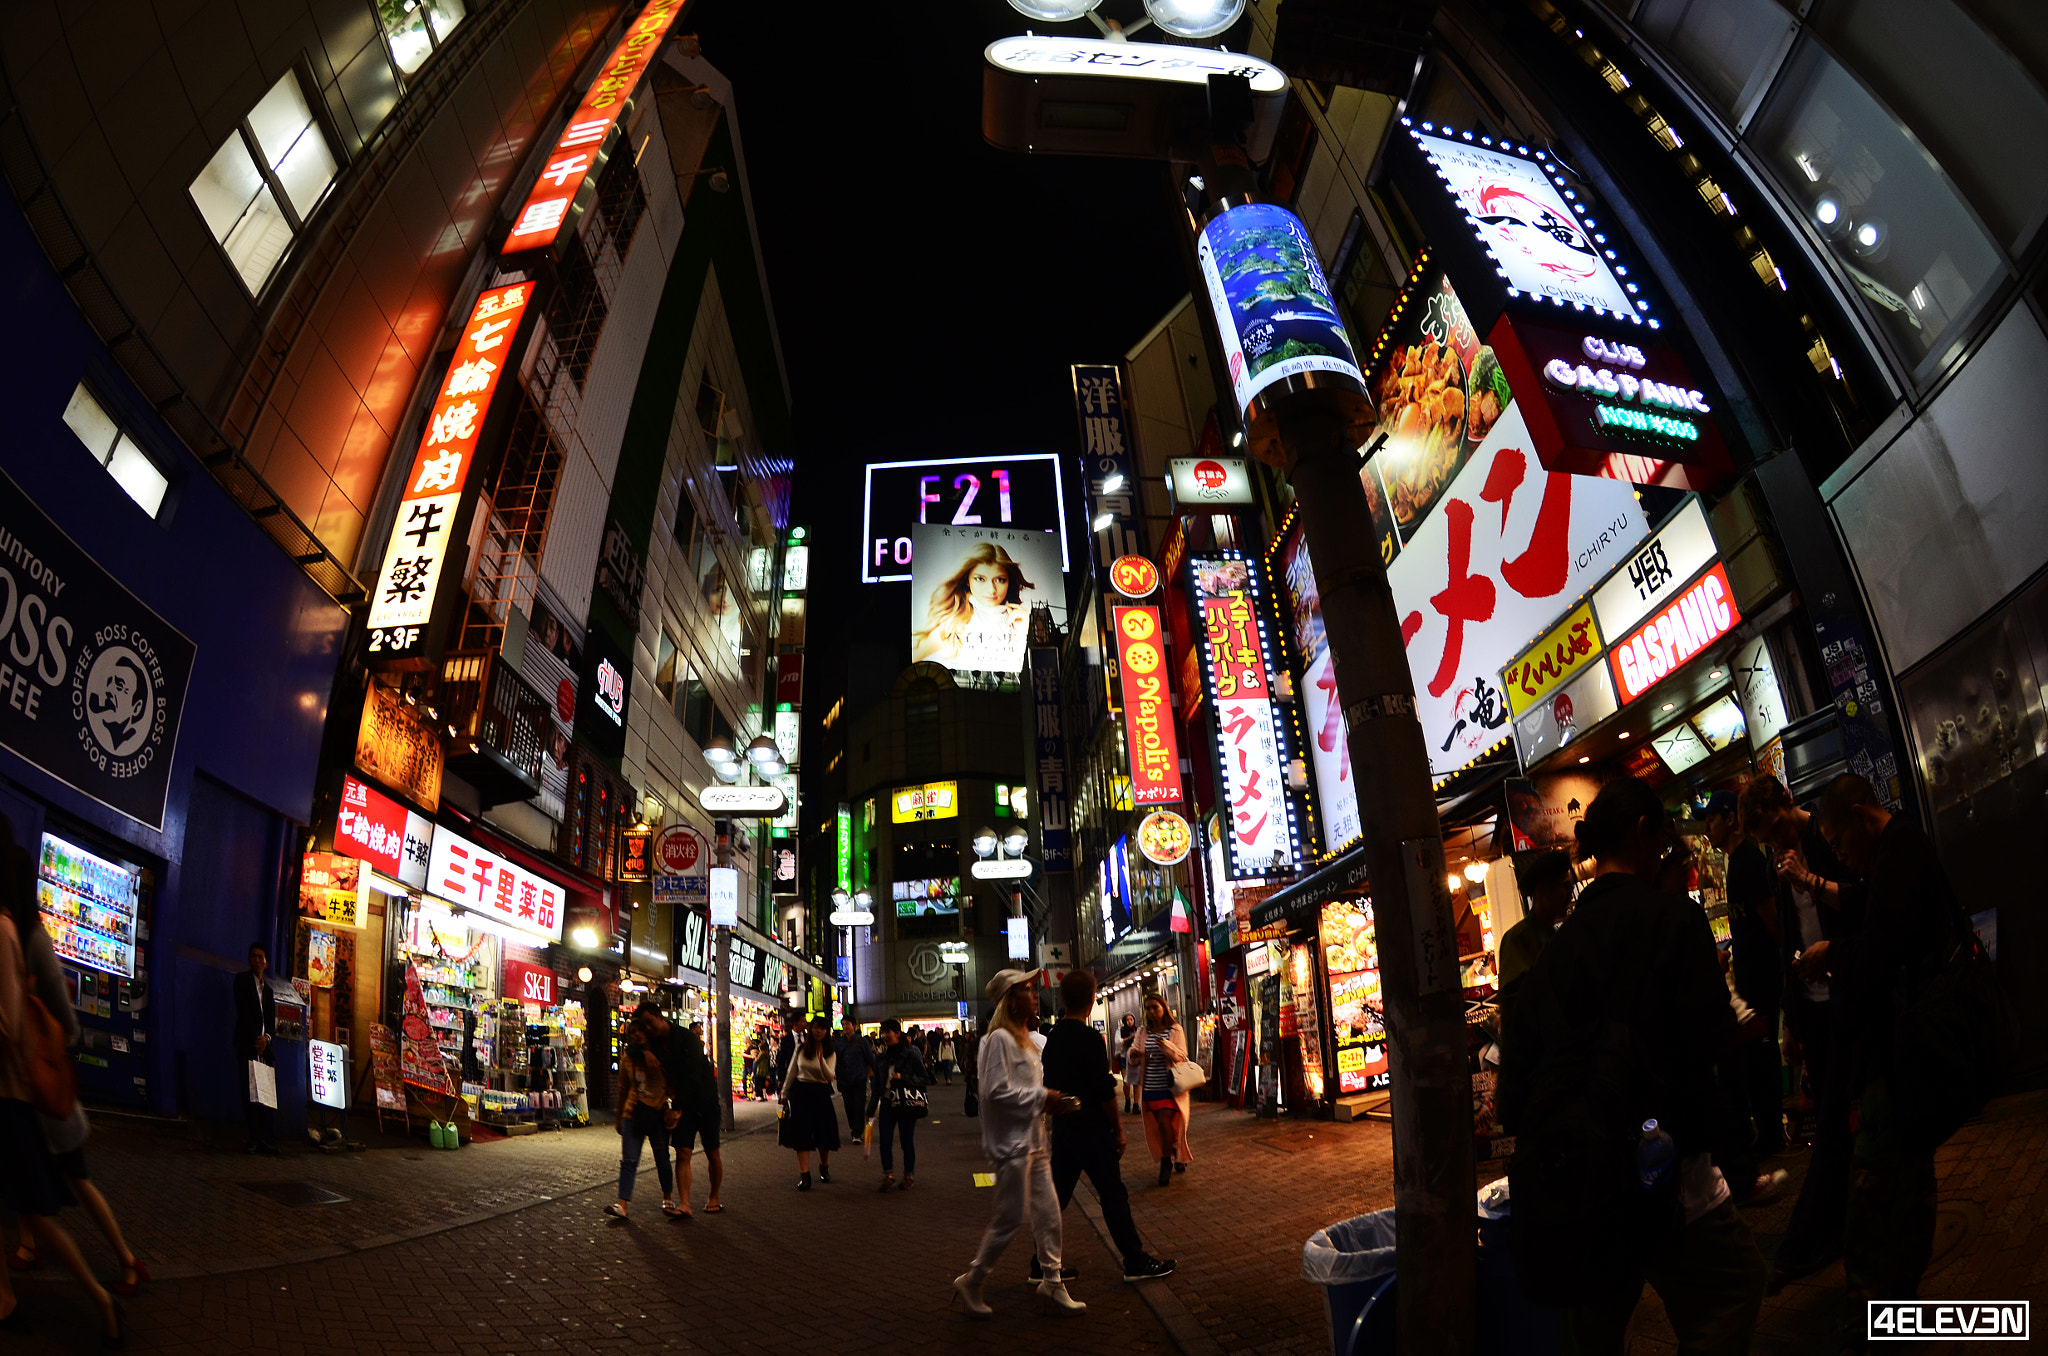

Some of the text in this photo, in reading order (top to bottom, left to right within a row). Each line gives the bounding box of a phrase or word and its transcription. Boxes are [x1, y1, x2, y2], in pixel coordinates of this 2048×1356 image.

[512, 118, 611, 237] 三千里
[1540, 283, 1609, 309] ICHIRYU
[1581, 335, 1647, 370] CLUB
[412, 317, 511, 494] 七輪焼肉
[920, 469, 1012, 526] F21
[1081, 377, 1141, 568] 洋服の青山
[384, 503, 443, 604] 牛繁
[1573, 513, 1629, 573] ICHIRYU
[1207, 606, 1238, 698] ハンバーグ
[1519, 616, 1594, 697] くいしんぼ
[1617, 575, 1732, 698] GASPANIC
[1825, 642, 1841, 658] JS
[72, 624, 167, 778] BOSS COFFEE BOSS COFFEE BOSS COFFEE
[597, 658, 624, 714] HUB
[1859, 682, 1875, 697] JS
[1136, 677, 1171, 783] Napoli's
[1758, 703, 1773, 729] 5F
[1036, 666, 1067, 831] 洋服の青山
[1222, 705, 1269, 846] ラーメン
[1136, 786, 1180, 801] ナポリス
[1266, 777, 1286, 845] 中洲屋台
[339, 806, 400, 860] 七輪焼肉
[405, 832, 430, 868] 牛繁
[665, 843, 697, 859] 消火栓
[443, 843, 556, 930] 三千里薬品
[625, 858, 645, 871] HUB
[1240, 856, 1290, 868] ICHIRU
[328, 898, 357, 918] 牛繁
[312, 1045, 326, 1099] 営業中
[1340, 1051, 1363, 1065] 24h
